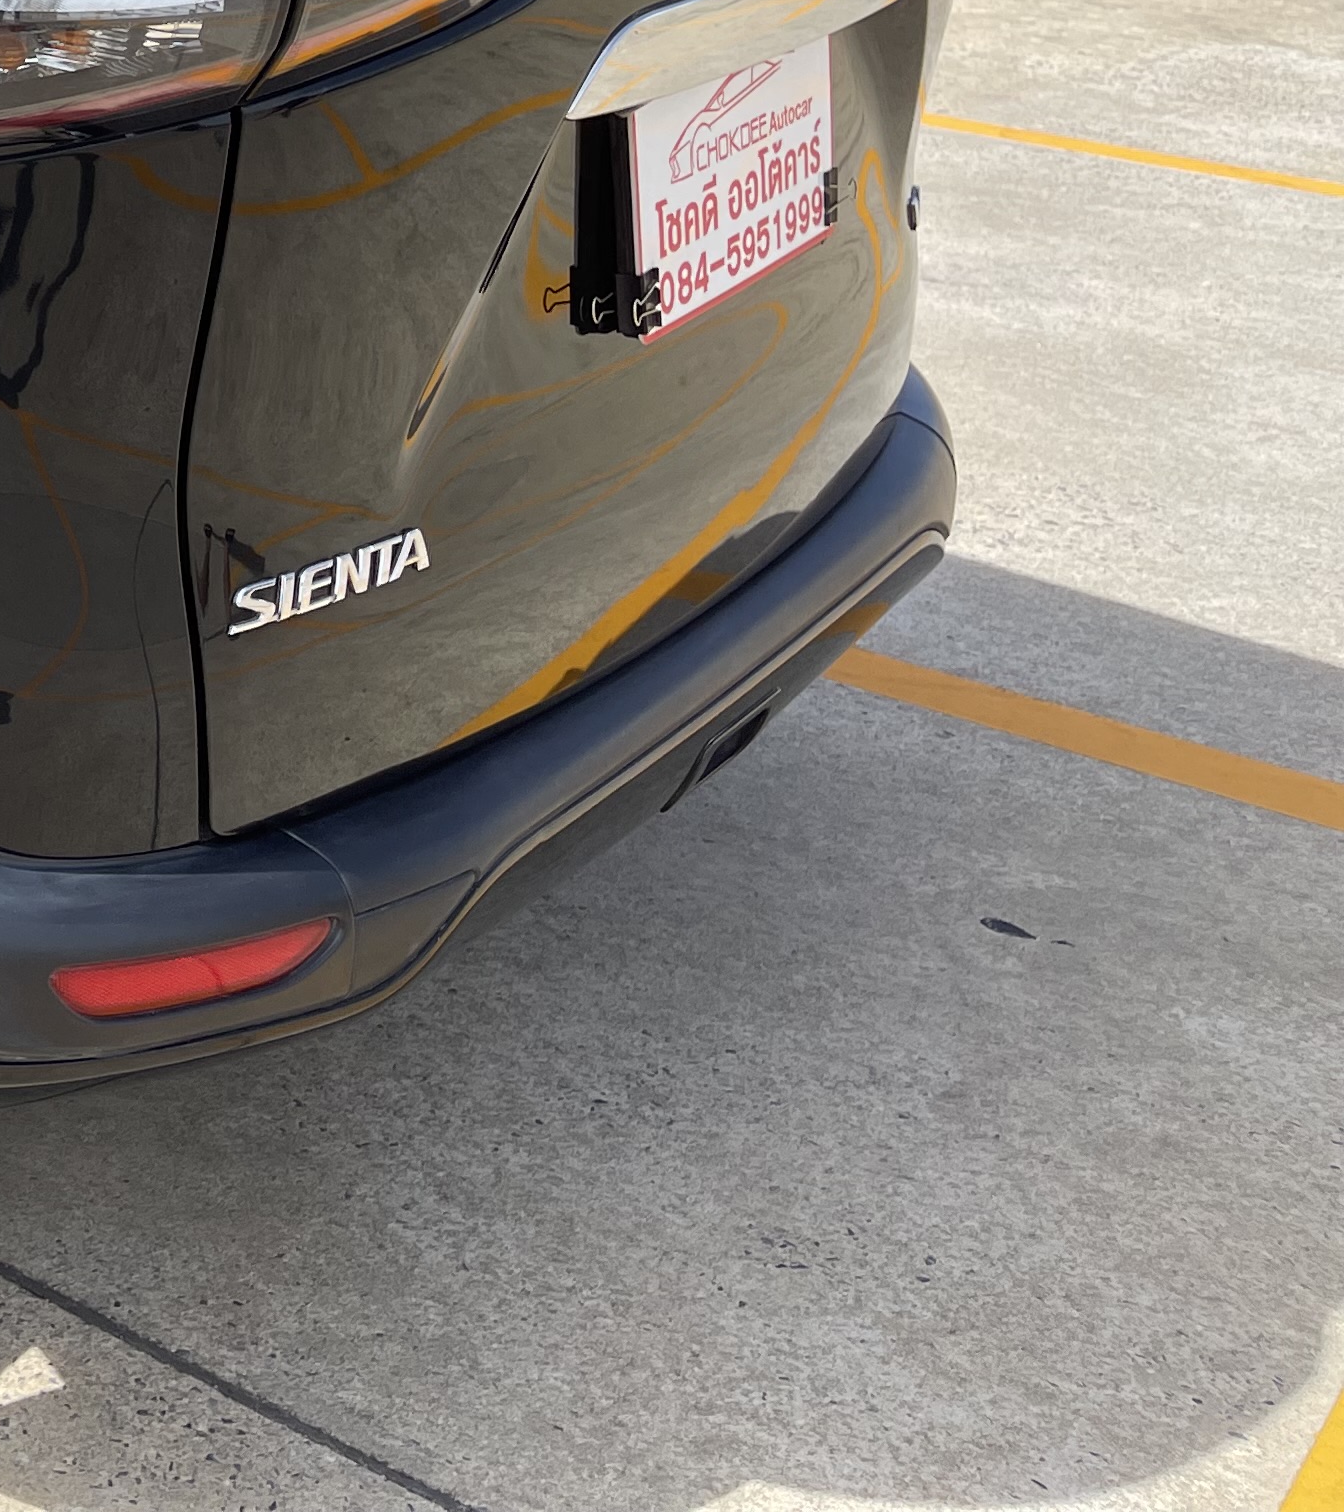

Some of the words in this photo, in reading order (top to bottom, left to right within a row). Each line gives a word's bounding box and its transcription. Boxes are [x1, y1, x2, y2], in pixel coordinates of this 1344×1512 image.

[654, 173, 719, 259] โชคดี
[727, 117, 821, 221] ออโต้คาร์
[695, 112, 768, 172] CHOKDEE
[769, 96, 813, 136] Autocar
[660, 185, 824, 315] 084-5951999
[226, 526, 431, 636] SIENTA
